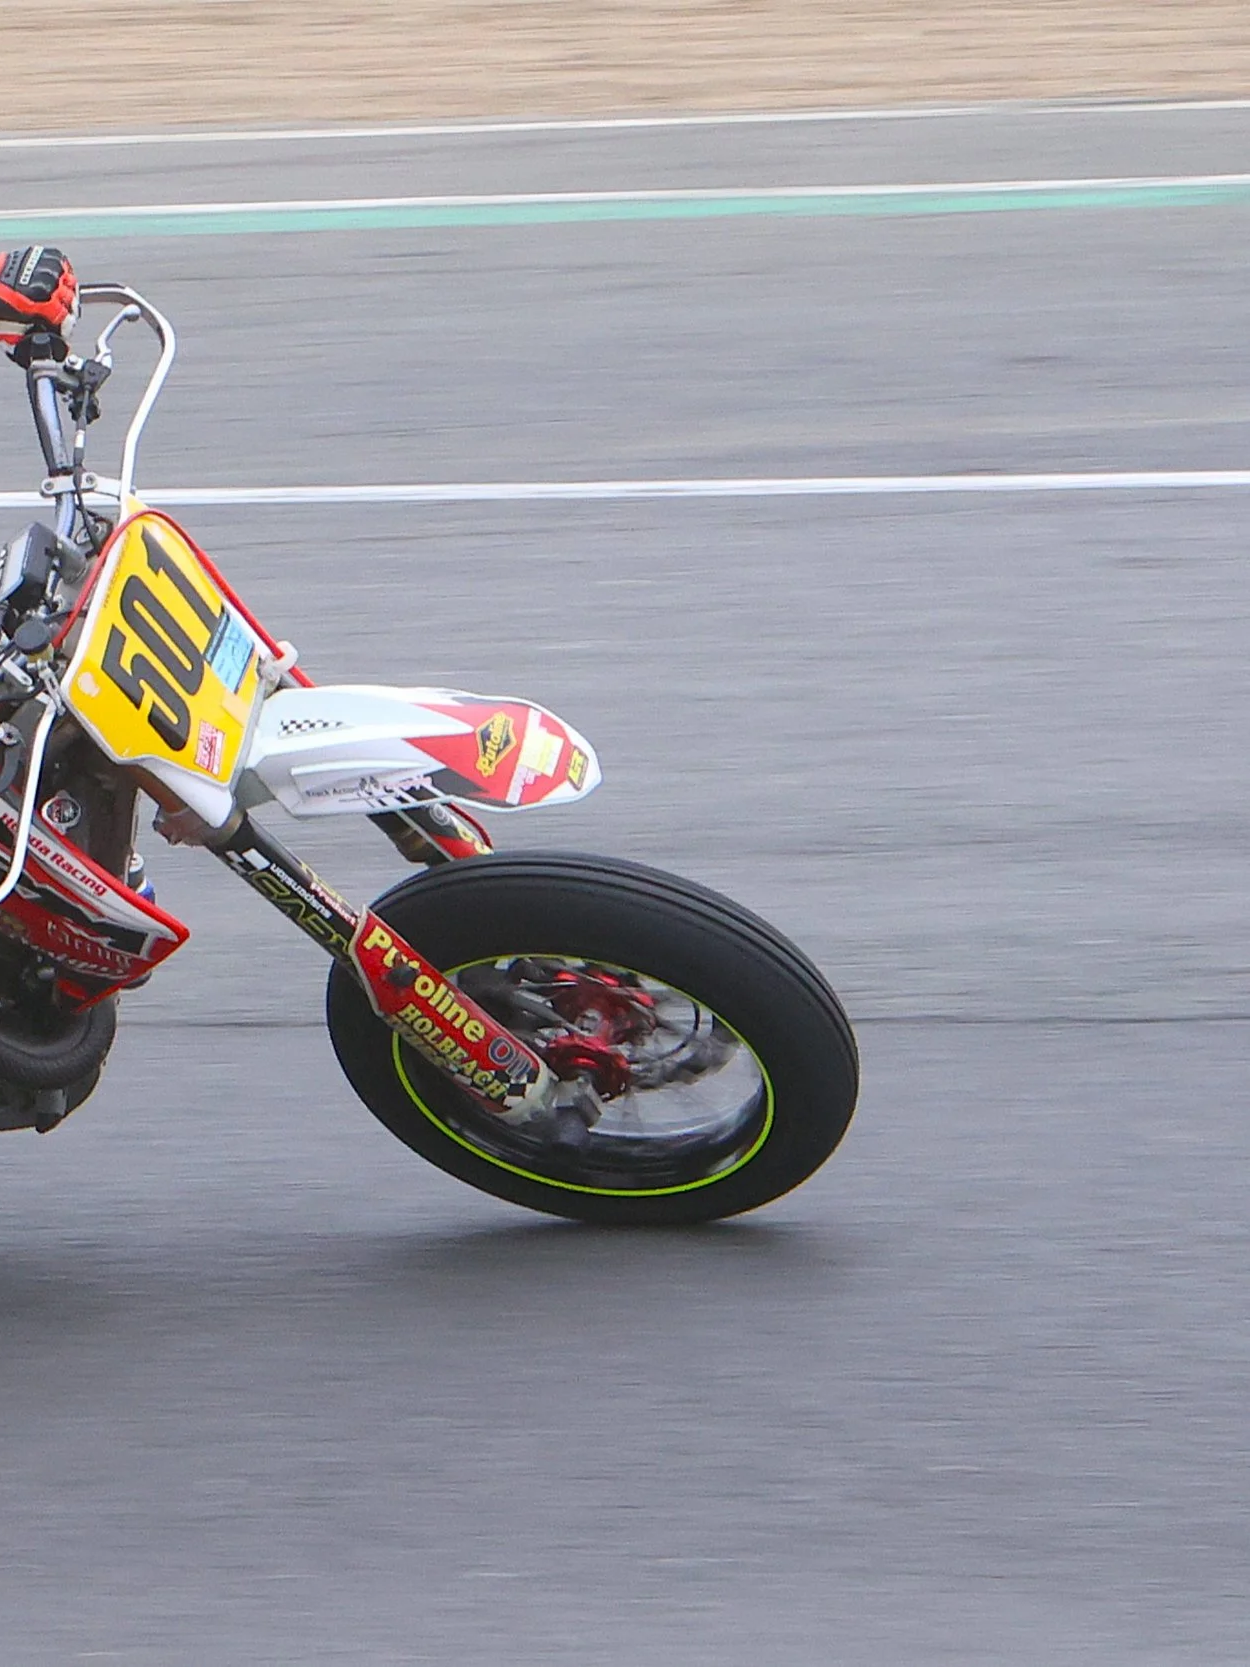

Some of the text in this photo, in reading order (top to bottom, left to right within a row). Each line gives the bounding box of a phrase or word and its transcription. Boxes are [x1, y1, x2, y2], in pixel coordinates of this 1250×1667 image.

[102, 526, 226, 752] 501
[50, 850, 108, 896] Racing
[269, 861, 333, 920] suspension
[396, 1002, 509, 1100] HOLBEACH
